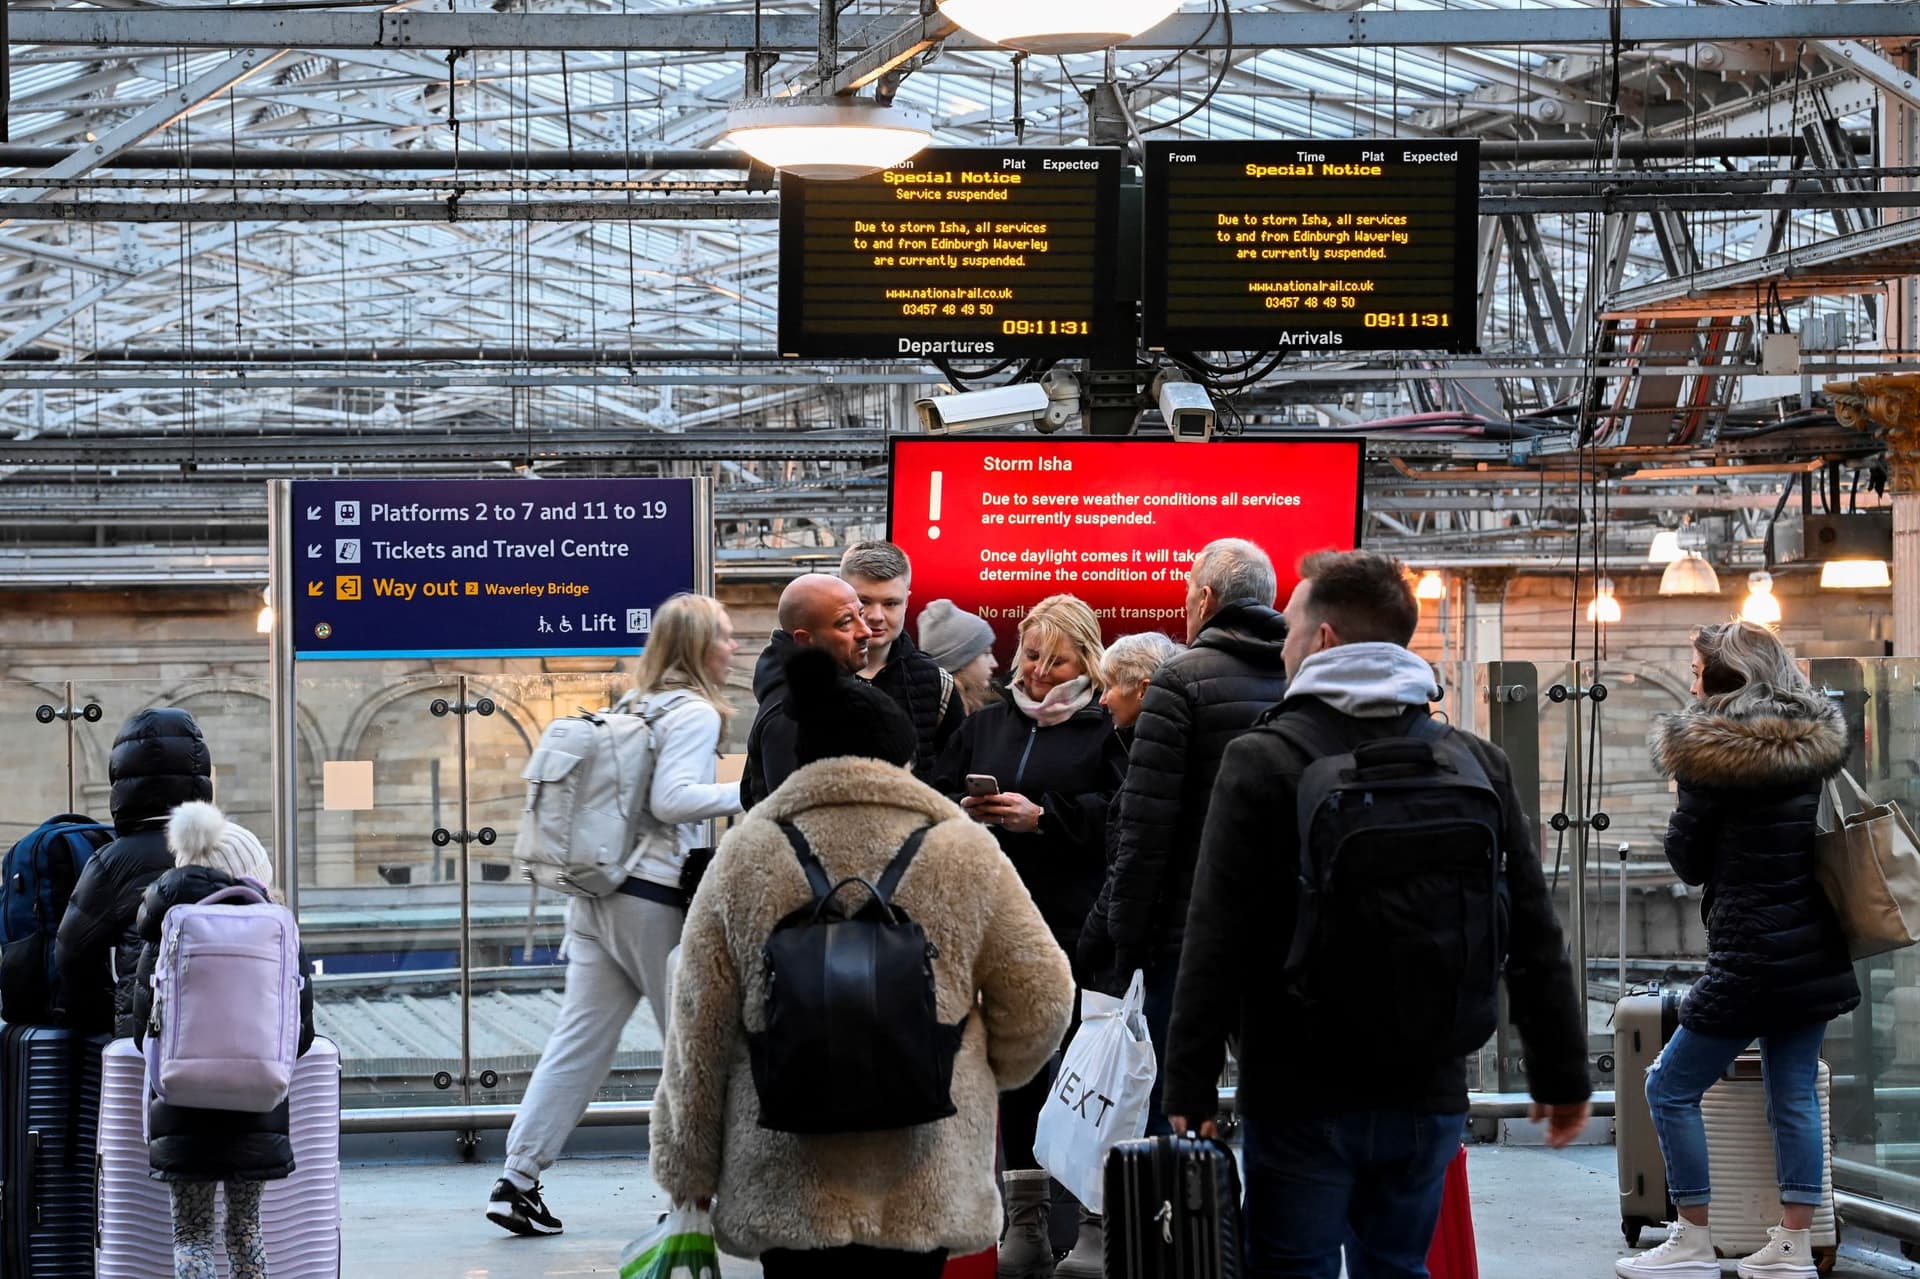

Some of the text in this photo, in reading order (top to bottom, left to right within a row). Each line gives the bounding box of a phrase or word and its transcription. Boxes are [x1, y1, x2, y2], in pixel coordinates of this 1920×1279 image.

[1169, 152, 1457, 163] From Time Plat Expected
[1003, 159, 1098, 171] Plat Expected
[1246, 164, 1381, 177] Special Notice
[883, 172, 1021, 185] Special Notice
[897, 189, 1007, 202] Service suspended
[1218, 215, 1407, 227] Due to storm Isha, all services
[855, 222, 1046, 234] Due to storm Isha, all services
[1217, 231, 1408, 244] to and from Edinburgh Waverley
[854, 239, 1047, 251] to and from Edinburgh Waverley
[1237, 248, 1386, 260] are currently suspended.
[874, 255, 1025, 268] are currently suspended.
[1249, 281, 1373, 291] www.nationalrail.co.uk
[886, 288, 1012, 299] www.nationalrail.co.uk
[1266, 297, 1355, 307] 03457 48 49 50
[903, 304, 993, 315] 03457 48 49 50
[1365, 313, 1448, 327] 09:11:31
[1003, 321, 1088, 334] 09:11:31
[1279, 331, 1342, 345] Arrivals
[899, 339, 994, 355] Departures
[984, 456, 1072, 471] Storm Isha
[982, 493, 1300, 506] Due to severe weather conditions all services
[371, 501, 667, 521] Platforms 2 to 7 and 11 to 19
[982, 512, 1156, 528] are currently suspended.
[372, 539, 629, 559] Tickets and Travel Centre
[980, 550, 1016, 562] Once
[1021, 550, 1076, 566] daylight
[1081, 552, 1128, 562] comes
[1132, 550, 1140, 562] it
[1144, 550, 1169, 562] will
[979, 568, 1191, 581] determine the condition of the
[373, 578, 416, 600] Way
[423, 580, 458, 596] out
[485, 584, 544, 597] Waverley
[548, 583, 589, 596] Bridge
[979, 606, 998, 618] No
[1002, 605, 1024, 618] rail
[1120, 607, 1184, 622] transport
[582, 614, 616, 631] Lift
[1055, 1067, 1114, 1127] NEXT
